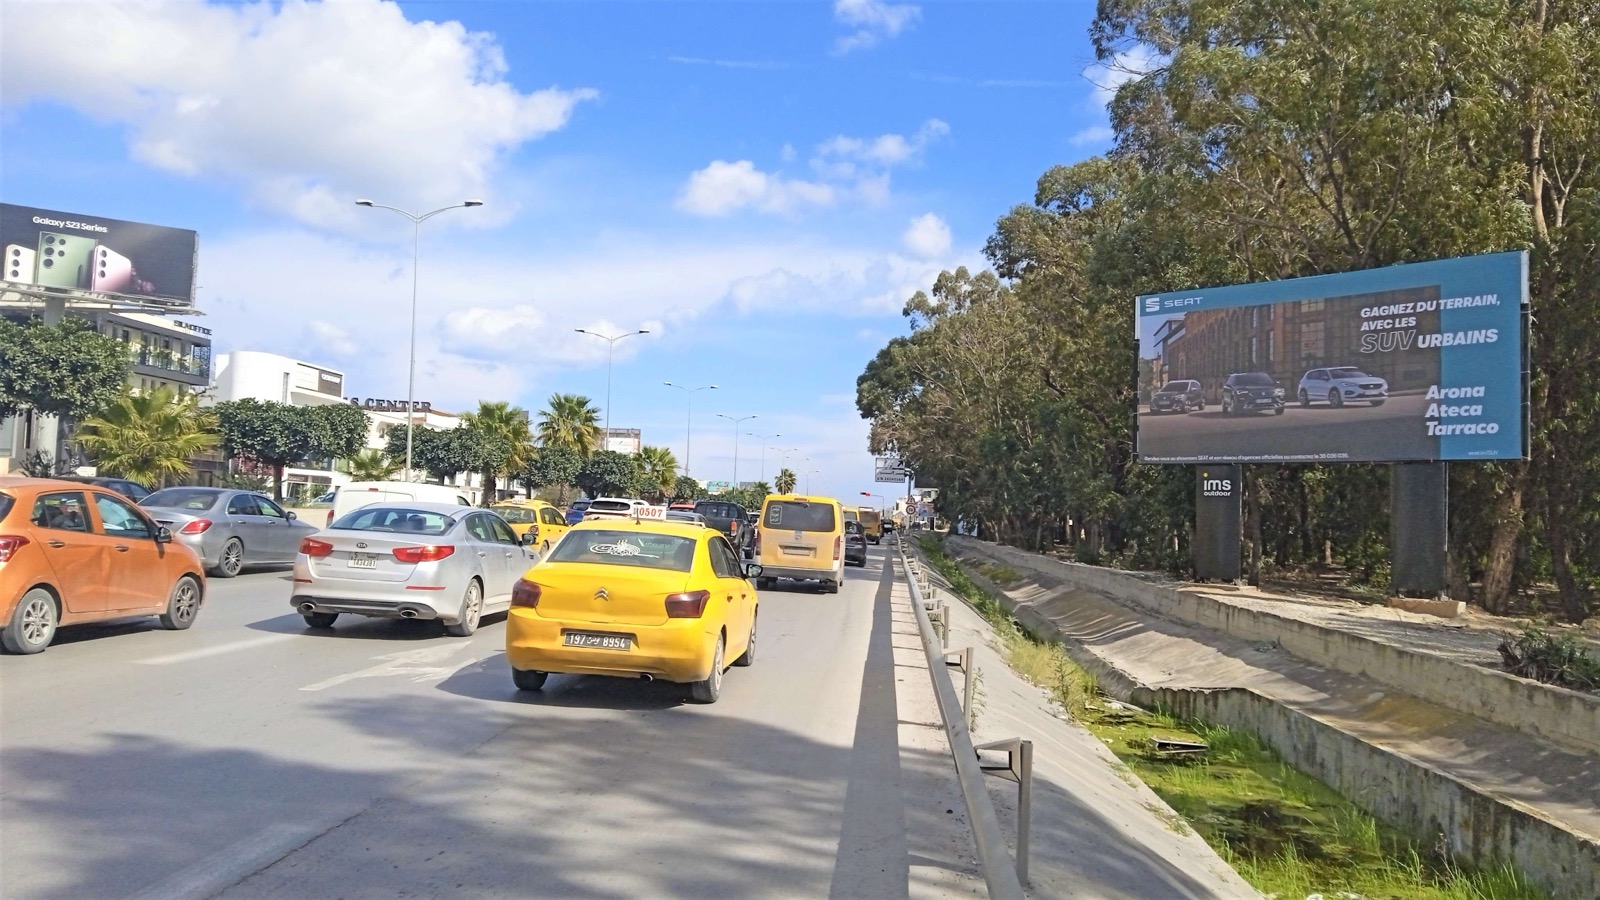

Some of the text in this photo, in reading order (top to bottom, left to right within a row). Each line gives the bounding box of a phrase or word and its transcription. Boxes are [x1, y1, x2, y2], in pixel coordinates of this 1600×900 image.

[32, 216, 108, 233] Galaxy S23 Series
[1164, 297, 1203, 308] SEAT
[1360, 294, 1500, 318] GAGNEZ DU TERRAIN,
[1360, 317, 1416, 331] AVEC LES
[1360, 328, 1499, 353] SUV URBAINS
[1425, 385, 1485, 400] Arona
[364, 397, 432, 413] CENTER
[1424, 403, 1483, 418] Ateca
[1425, 421, 1499, 436] Tarraco
[1203, 472, 1232, 490] ims
[639, 507, 663, 518] 0507
[569, 634, 586, 645] 197
[602, 637, 626, 648] 8954
